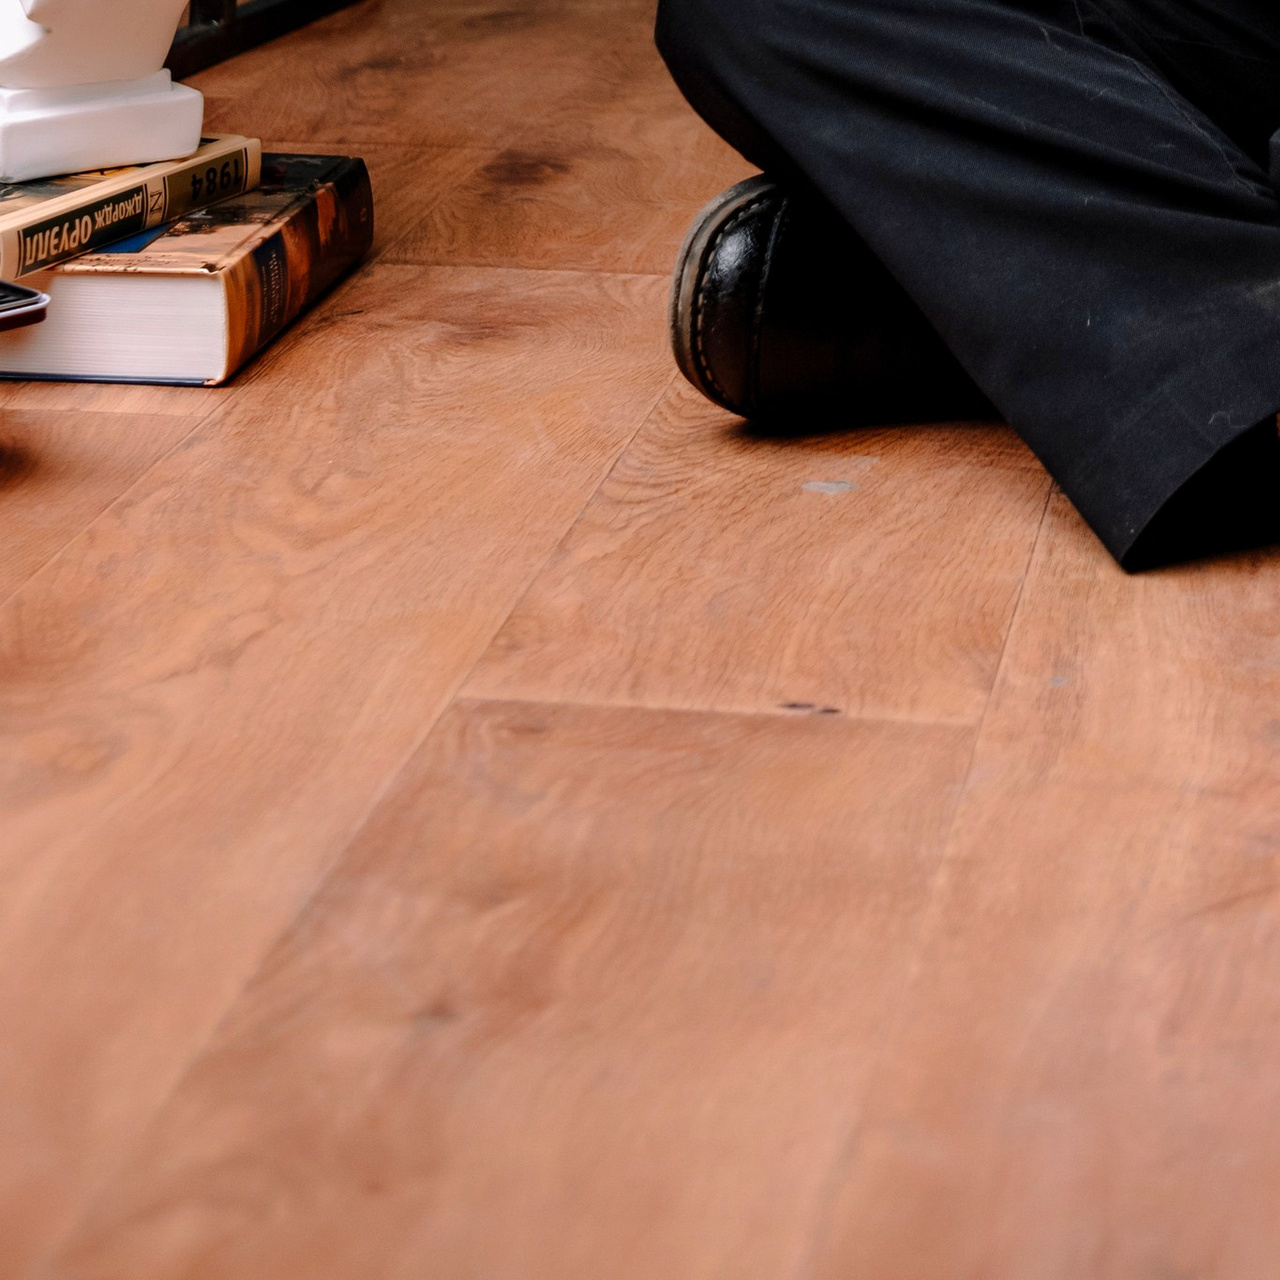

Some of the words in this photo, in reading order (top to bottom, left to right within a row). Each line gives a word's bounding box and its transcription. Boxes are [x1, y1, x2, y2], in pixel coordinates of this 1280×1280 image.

[190, 158, 243, 201] 1984
[93, 192, 143, 228] ДЖОРДЖ
[24, 214, 93, 266] ОРУЭЛЛ
